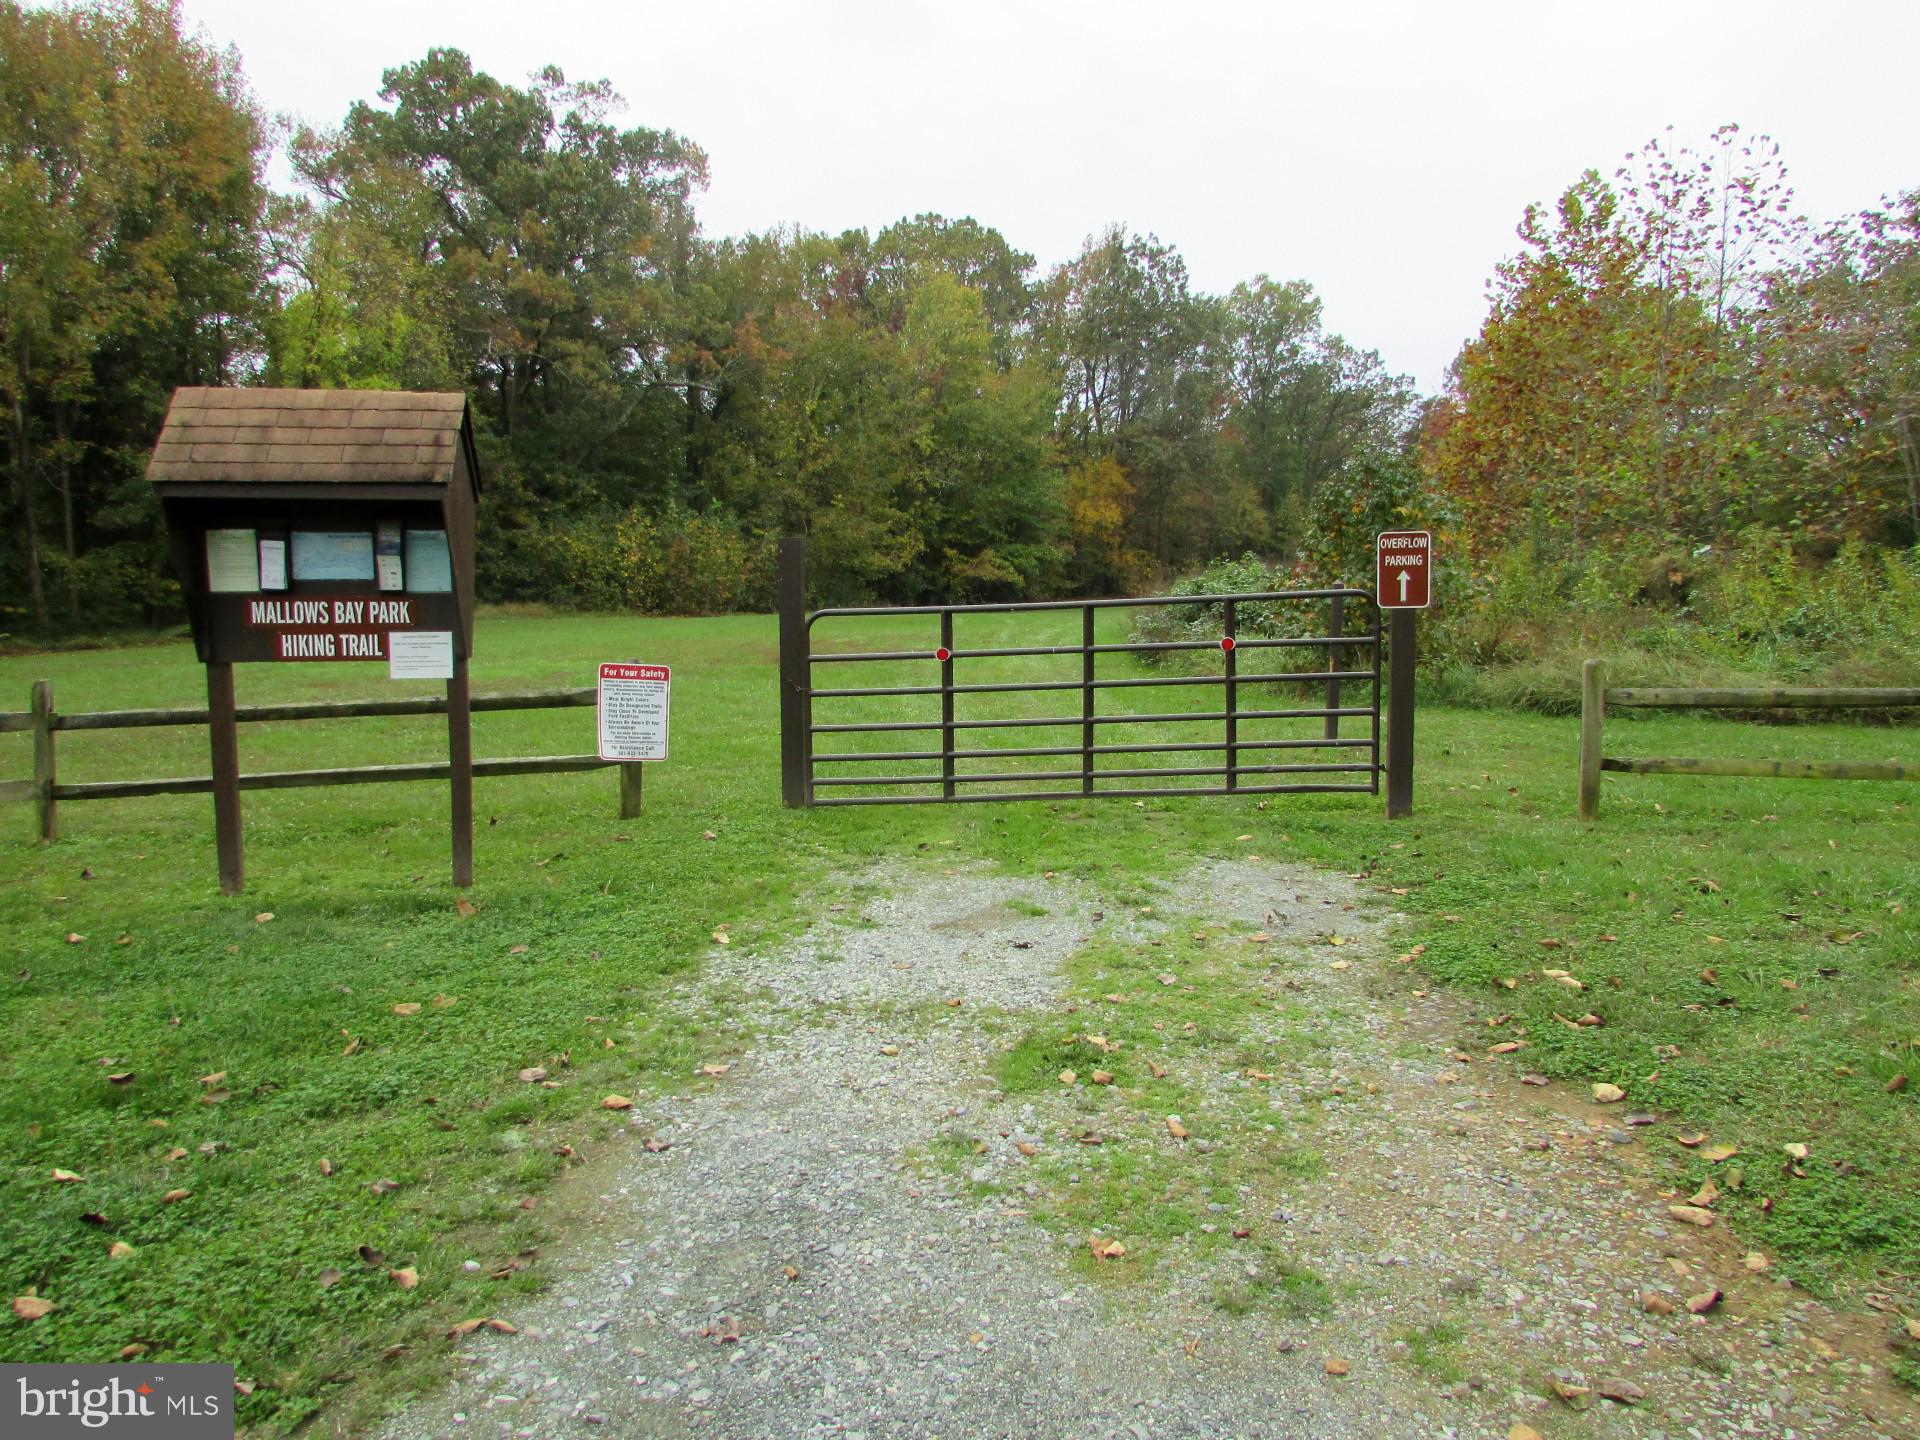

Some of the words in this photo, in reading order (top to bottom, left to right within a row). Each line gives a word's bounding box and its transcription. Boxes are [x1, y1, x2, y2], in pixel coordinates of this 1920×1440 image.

[1380, 537, 1428, 549] OVERFLOW
[1385, 555, 1423, 566] PARKING
[251, 601, 329, 624] MALLOWS
[334, 601, 364, 624] BAY
[369, 601, 411, 624] PARK
[282, 634, 335, 656] HIKING
[340, 633, 383, 656] TRAIL
[604, 667, 618, 676] For
[620, 668, 639, 677] Your
[640, 668, 666, 679] Safety
